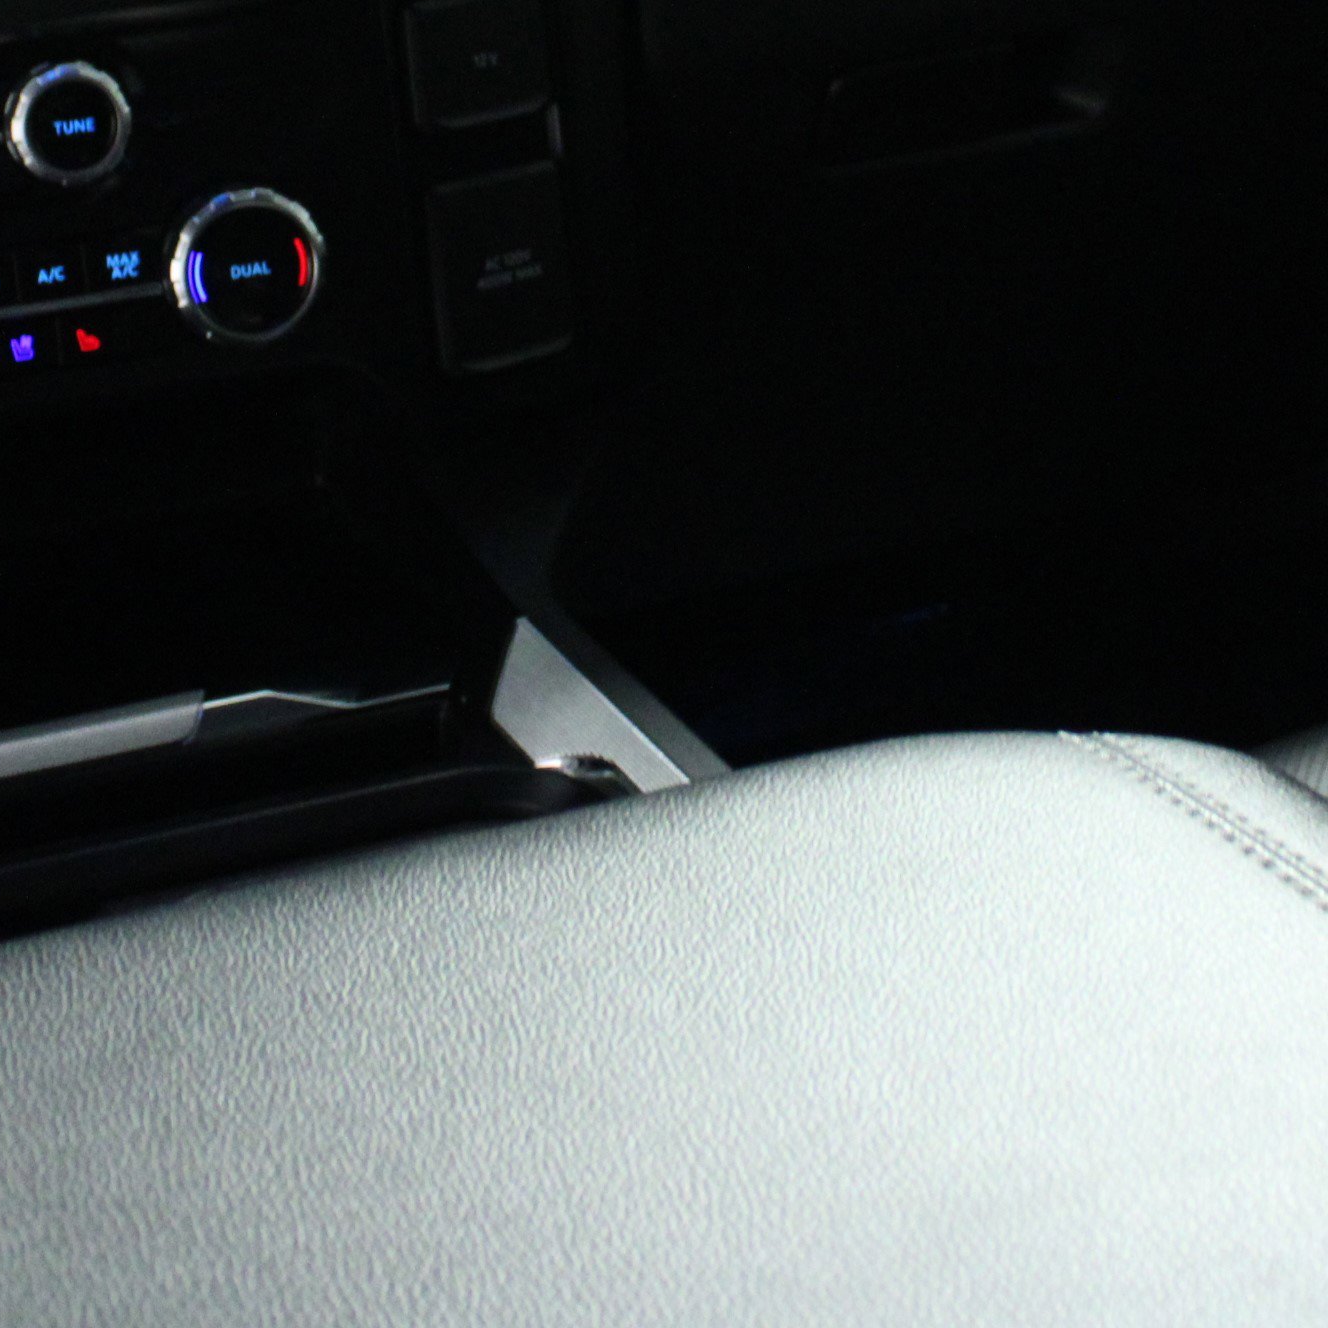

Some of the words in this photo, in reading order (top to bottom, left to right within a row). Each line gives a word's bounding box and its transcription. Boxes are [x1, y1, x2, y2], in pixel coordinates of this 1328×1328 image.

[54, 118, 95, 135] TUNE
[106, 251, 140, 269] MAX
[38, 266, 65, 284] A/C
[112, 264, 138, 279] A/C
[231, 262, 271, 279] DUAL
